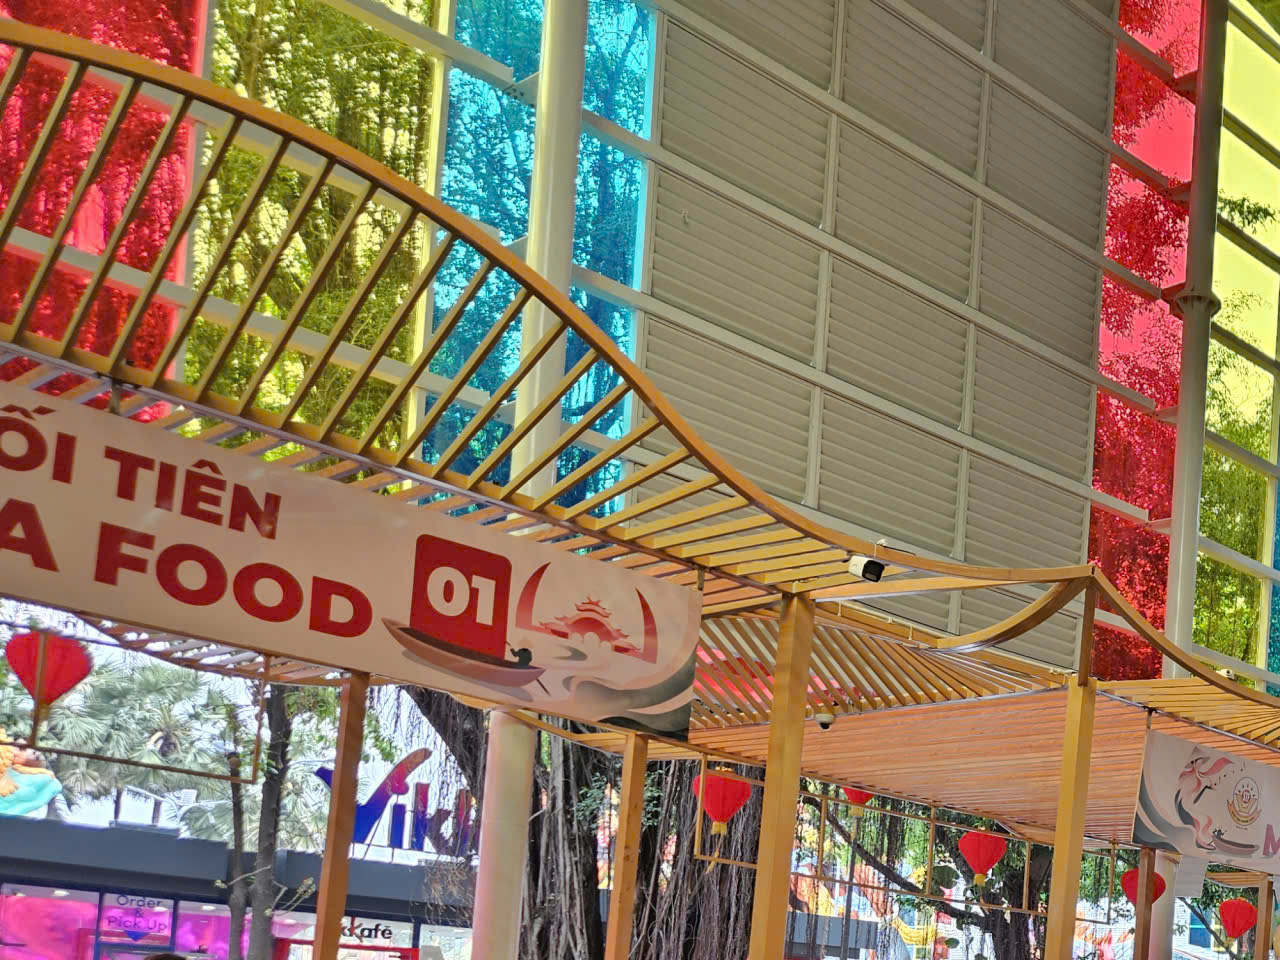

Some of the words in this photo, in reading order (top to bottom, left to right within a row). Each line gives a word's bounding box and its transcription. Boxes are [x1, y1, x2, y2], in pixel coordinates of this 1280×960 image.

[104, 445, 282, 540] TIÊN
[94, 521, 373, 638] FOOD
[427, 566, 496, 626] 01
[107, 916, 141, 929] Pick
[147, 919, 168, 933] Up
[117, 895, 163, 908] Order
